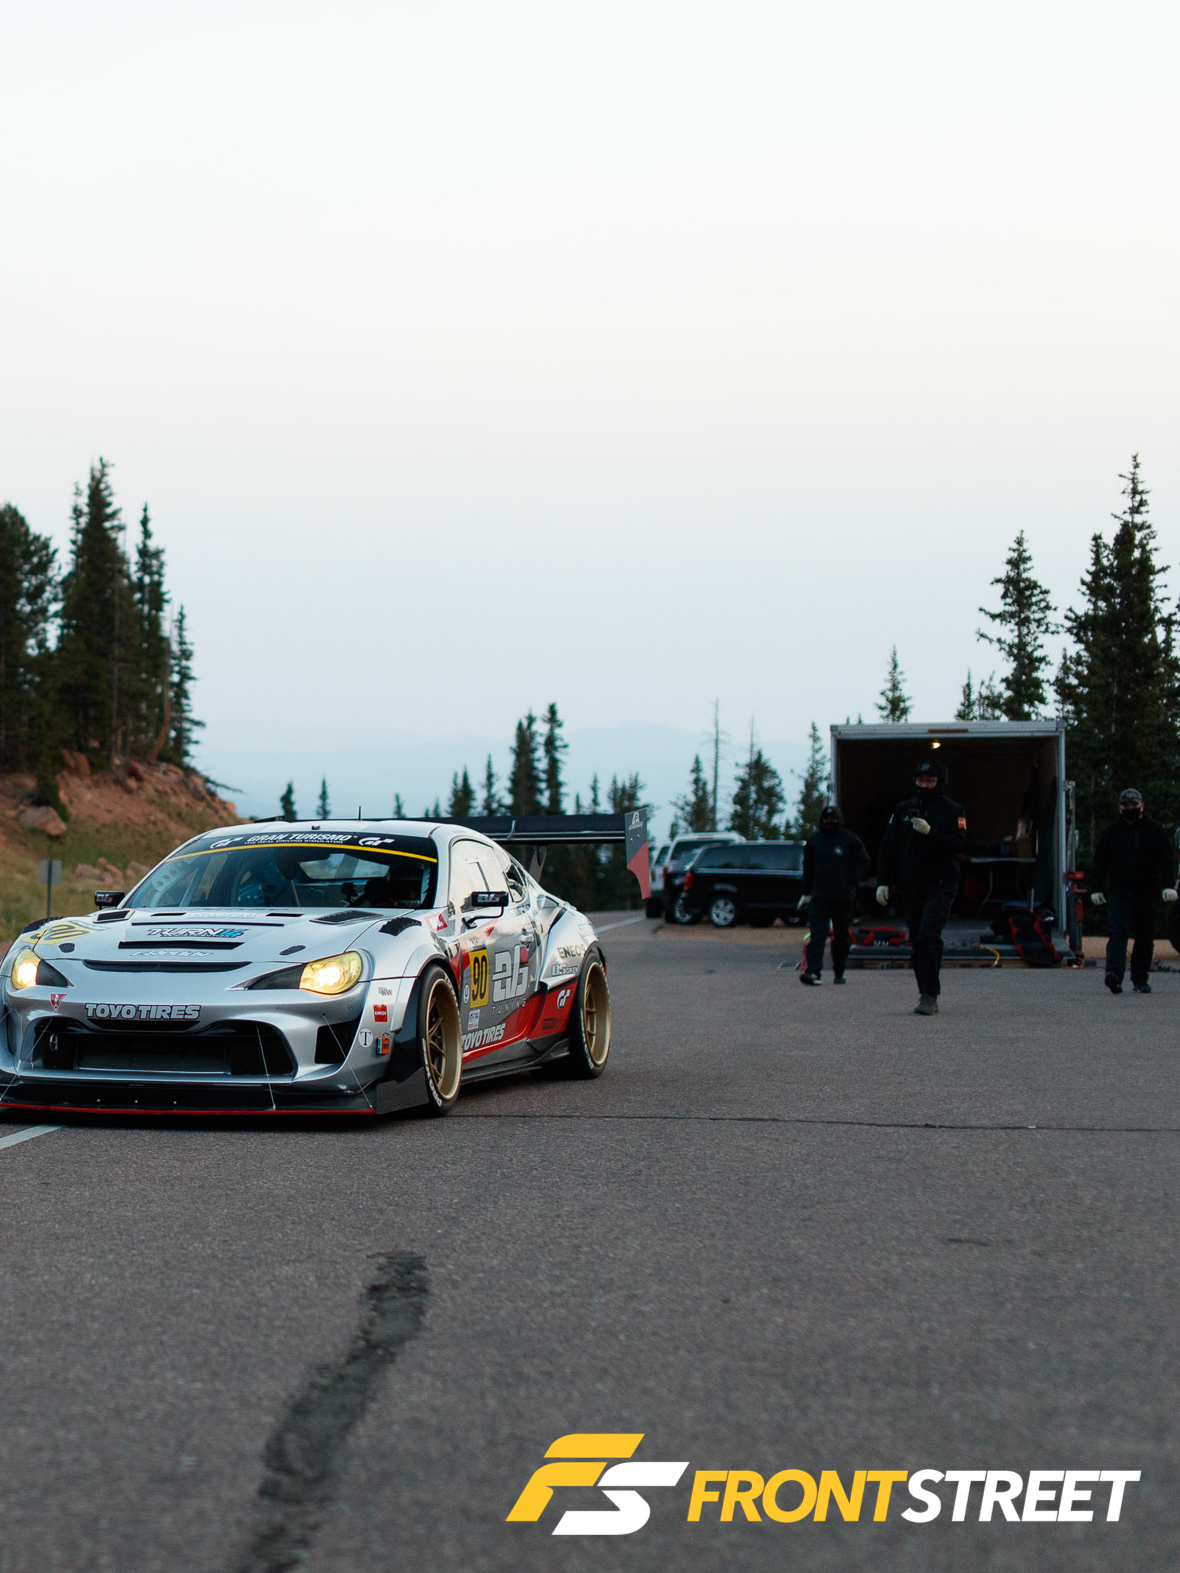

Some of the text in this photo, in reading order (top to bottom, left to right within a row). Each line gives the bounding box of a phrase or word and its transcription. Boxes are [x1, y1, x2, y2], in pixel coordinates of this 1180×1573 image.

[247, 833, 352, 842] GRAN TURISMO
[472, 955, 488, 1002] 90
[85, 1003, 202, 1020] TOYO TIRES
[461, 1022, 507, 1051] TOYO TIRES
